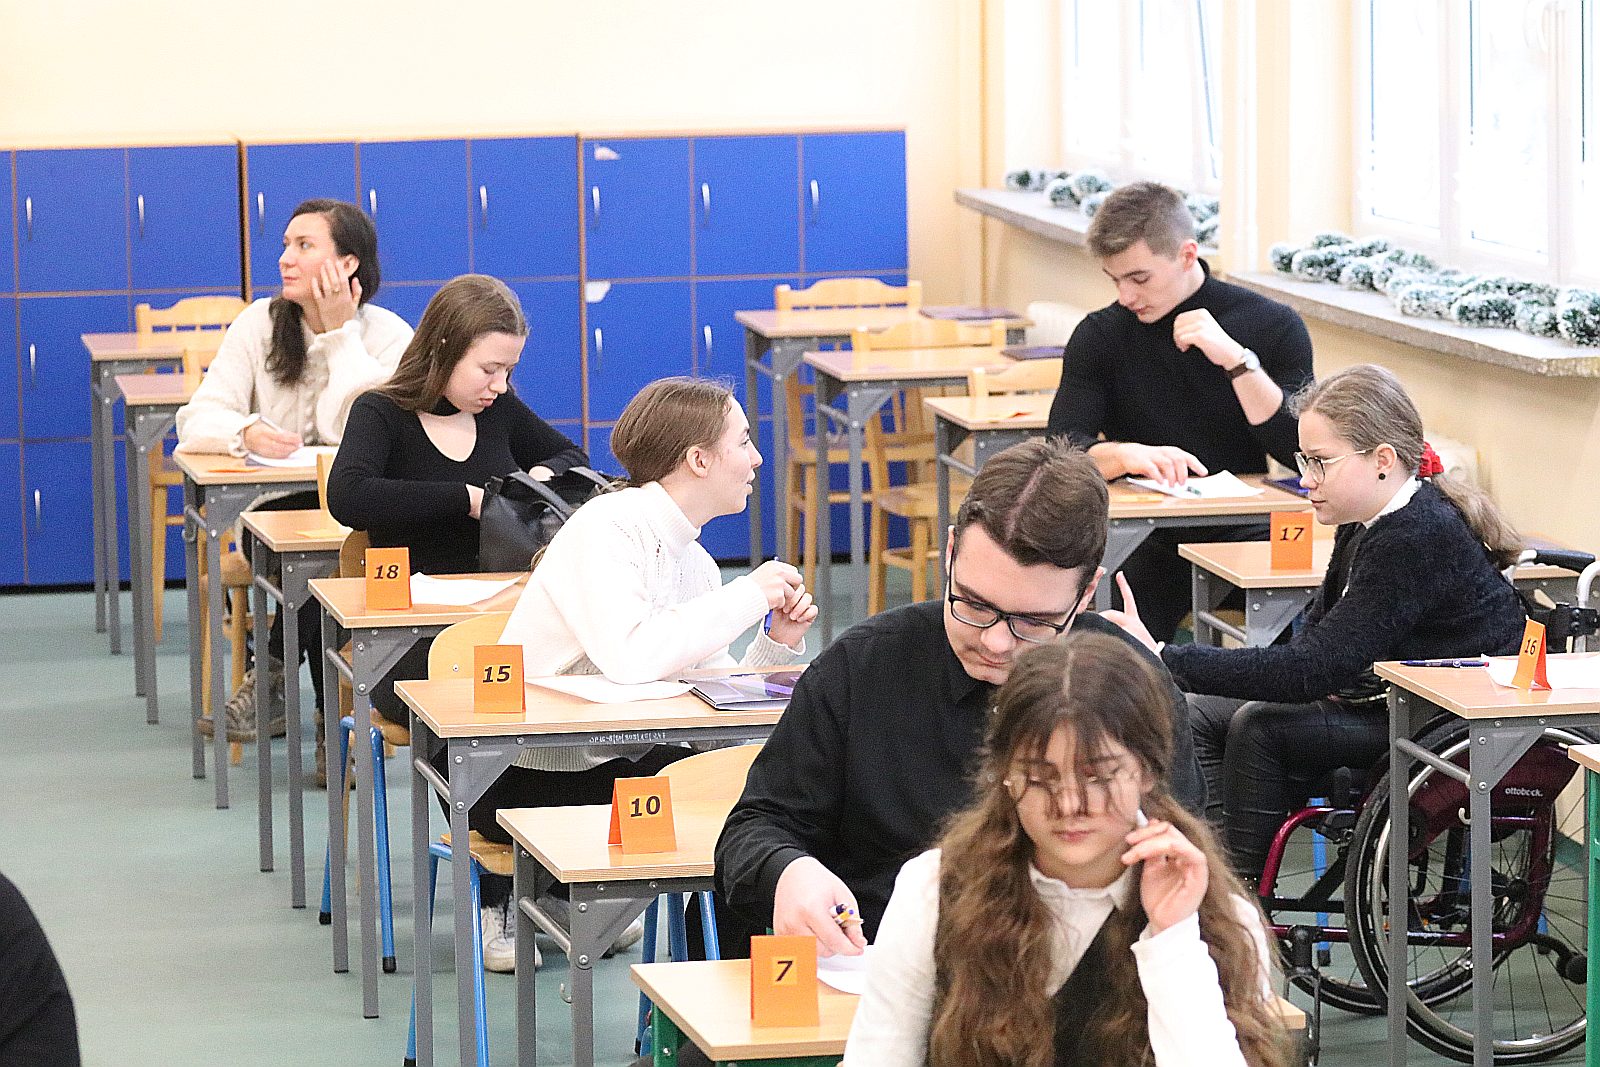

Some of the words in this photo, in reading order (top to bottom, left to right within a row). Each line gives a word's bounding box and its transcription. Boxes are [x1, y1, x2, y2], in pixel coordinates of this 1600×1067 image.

[1280, 527, 1305, 542] 17
[374, 564, 399, 580] 18
[1524, 638, 1537, 655] 16
[482, 665, 511, 683] 15
[630, 795, 661, 818] 10
[776, 960, 793, 982] 7
